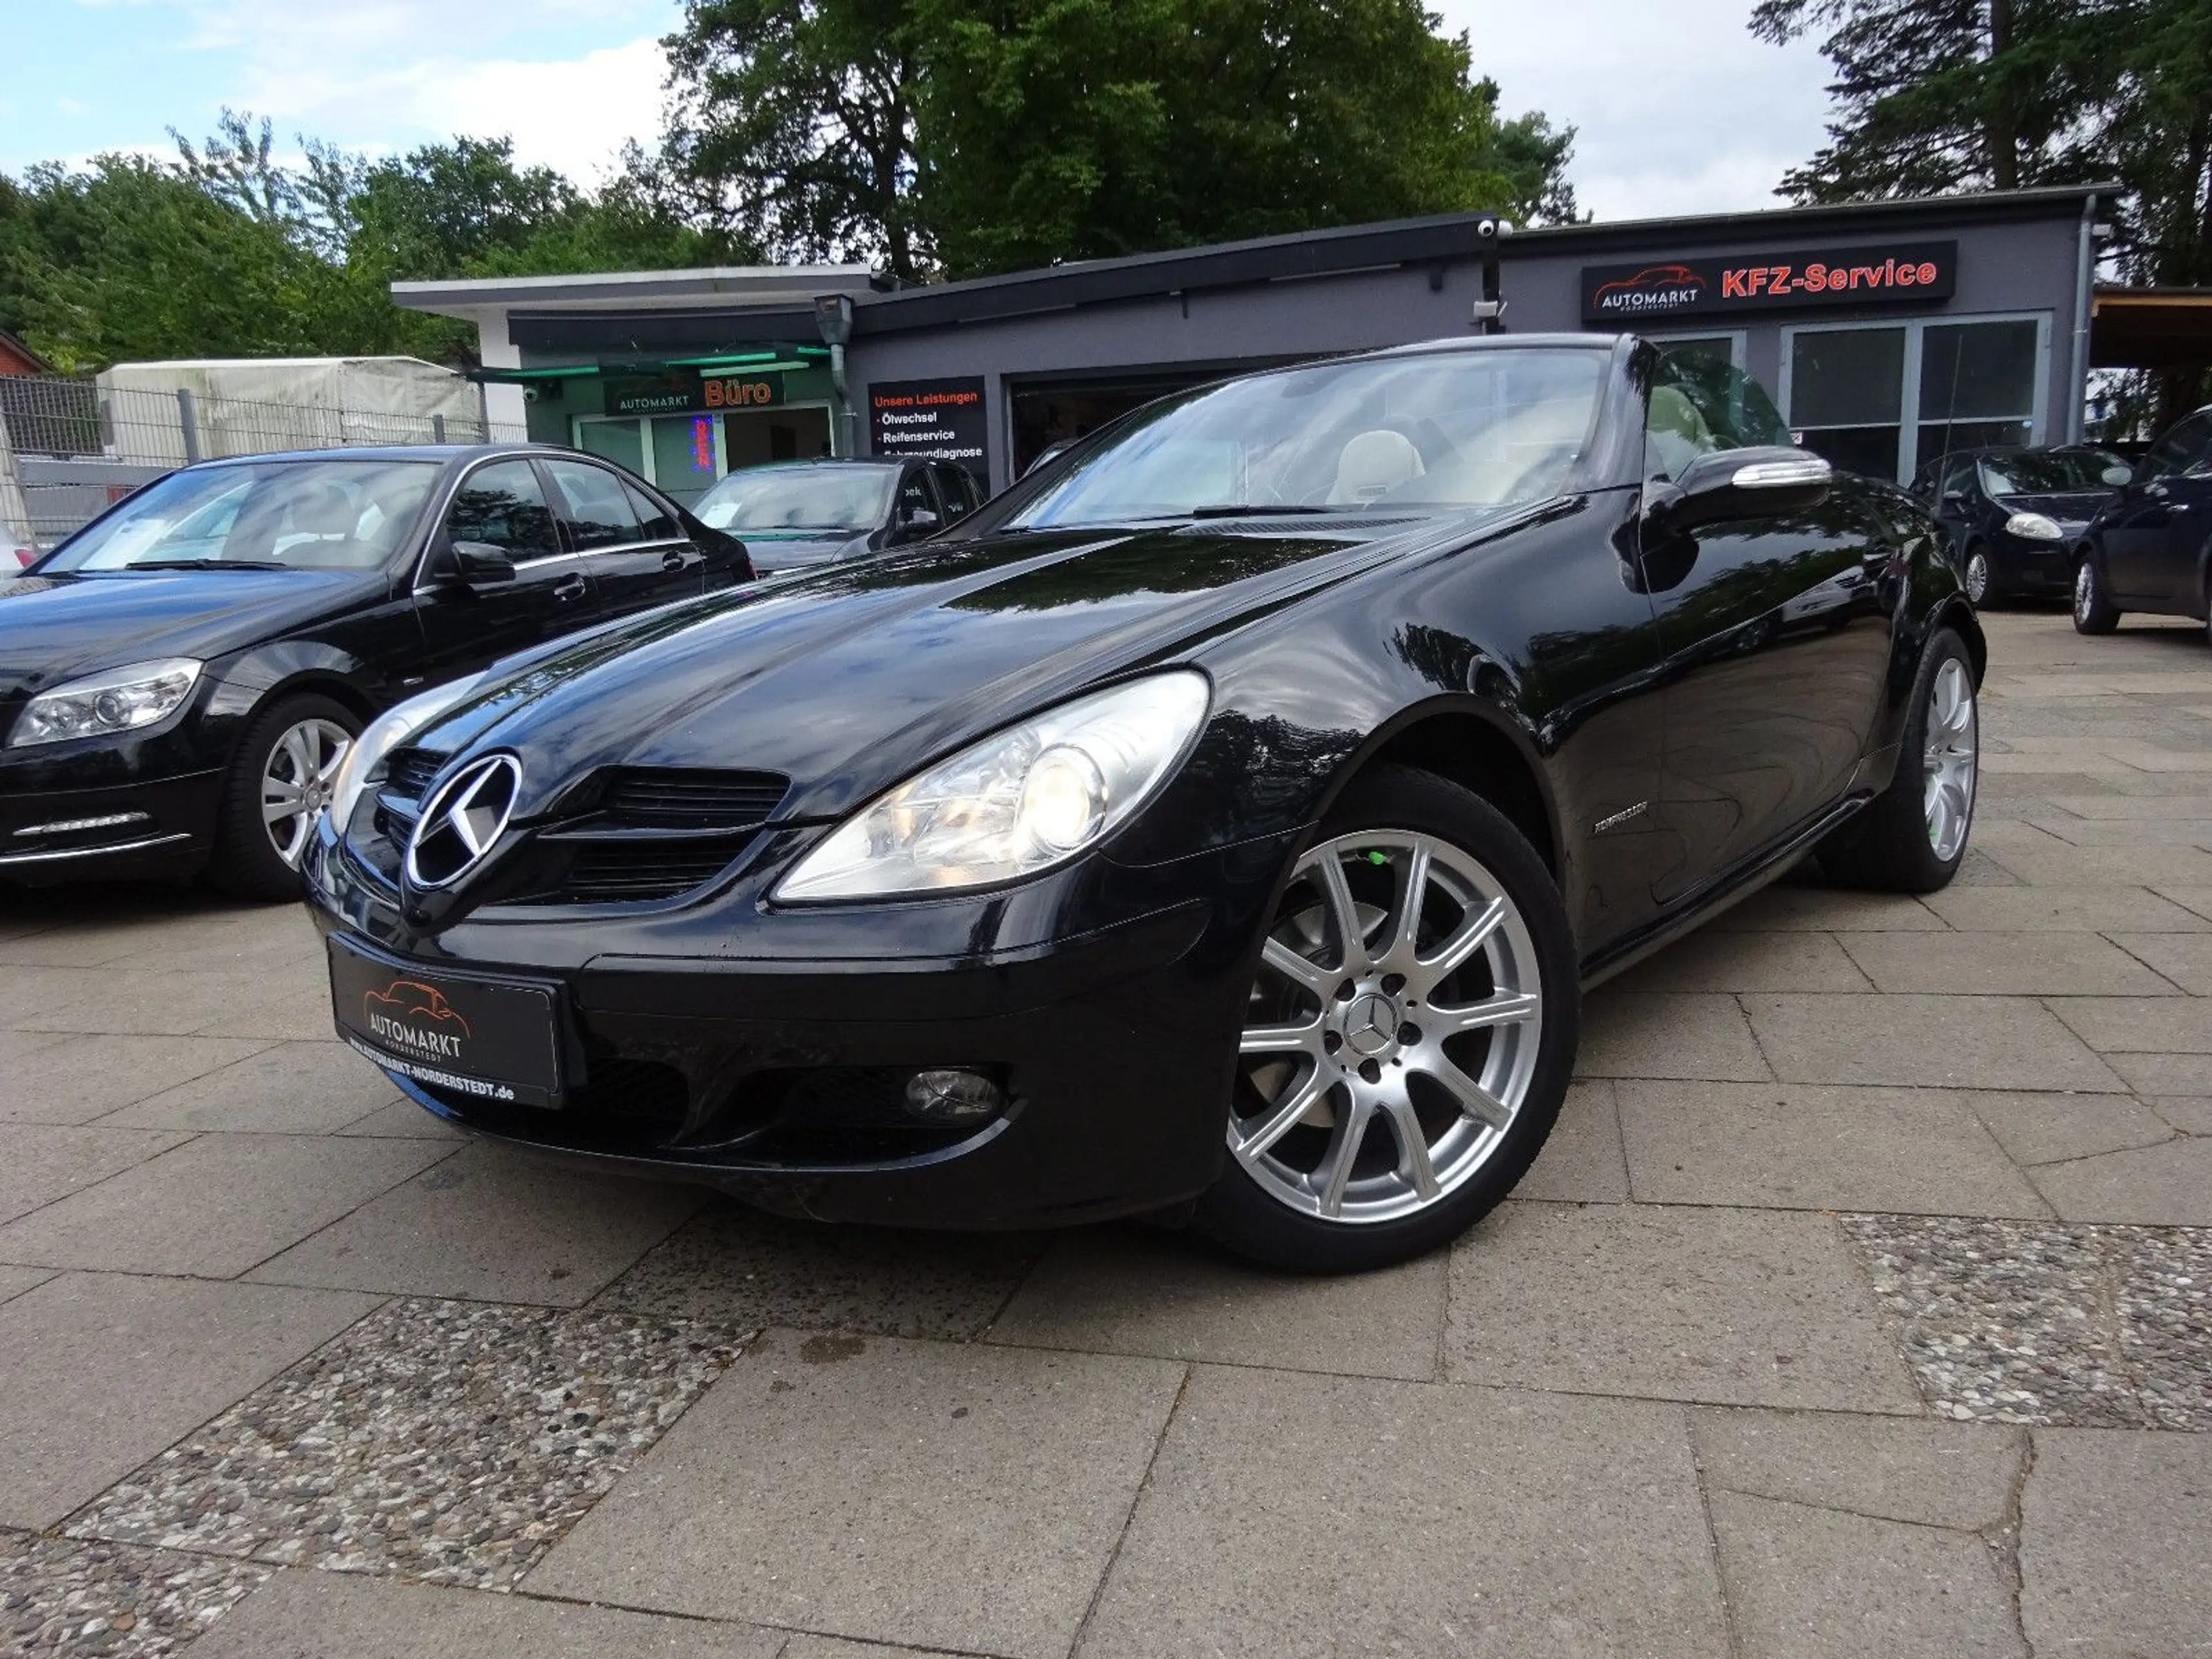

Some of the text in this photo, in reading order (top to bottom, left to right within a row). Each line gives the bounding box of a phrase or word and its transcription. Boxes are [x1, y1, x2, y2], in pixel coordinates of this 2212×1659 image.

[1722, 258, 1937, 298] KFZ-Service
[1602, 289, 1698, 308] AUTOMARKT
[704, 378, 771, 407] Büro
[874, 392, 978, 407] Unsere Leistungen
[620, 395, 689, 410] AUTOMARKT
[881, 411, 937, 425] Ölwechsel
[882, 430, 955, 444] Reifenservice
[370, 1013, 461, 1057] AUTOMARKT
